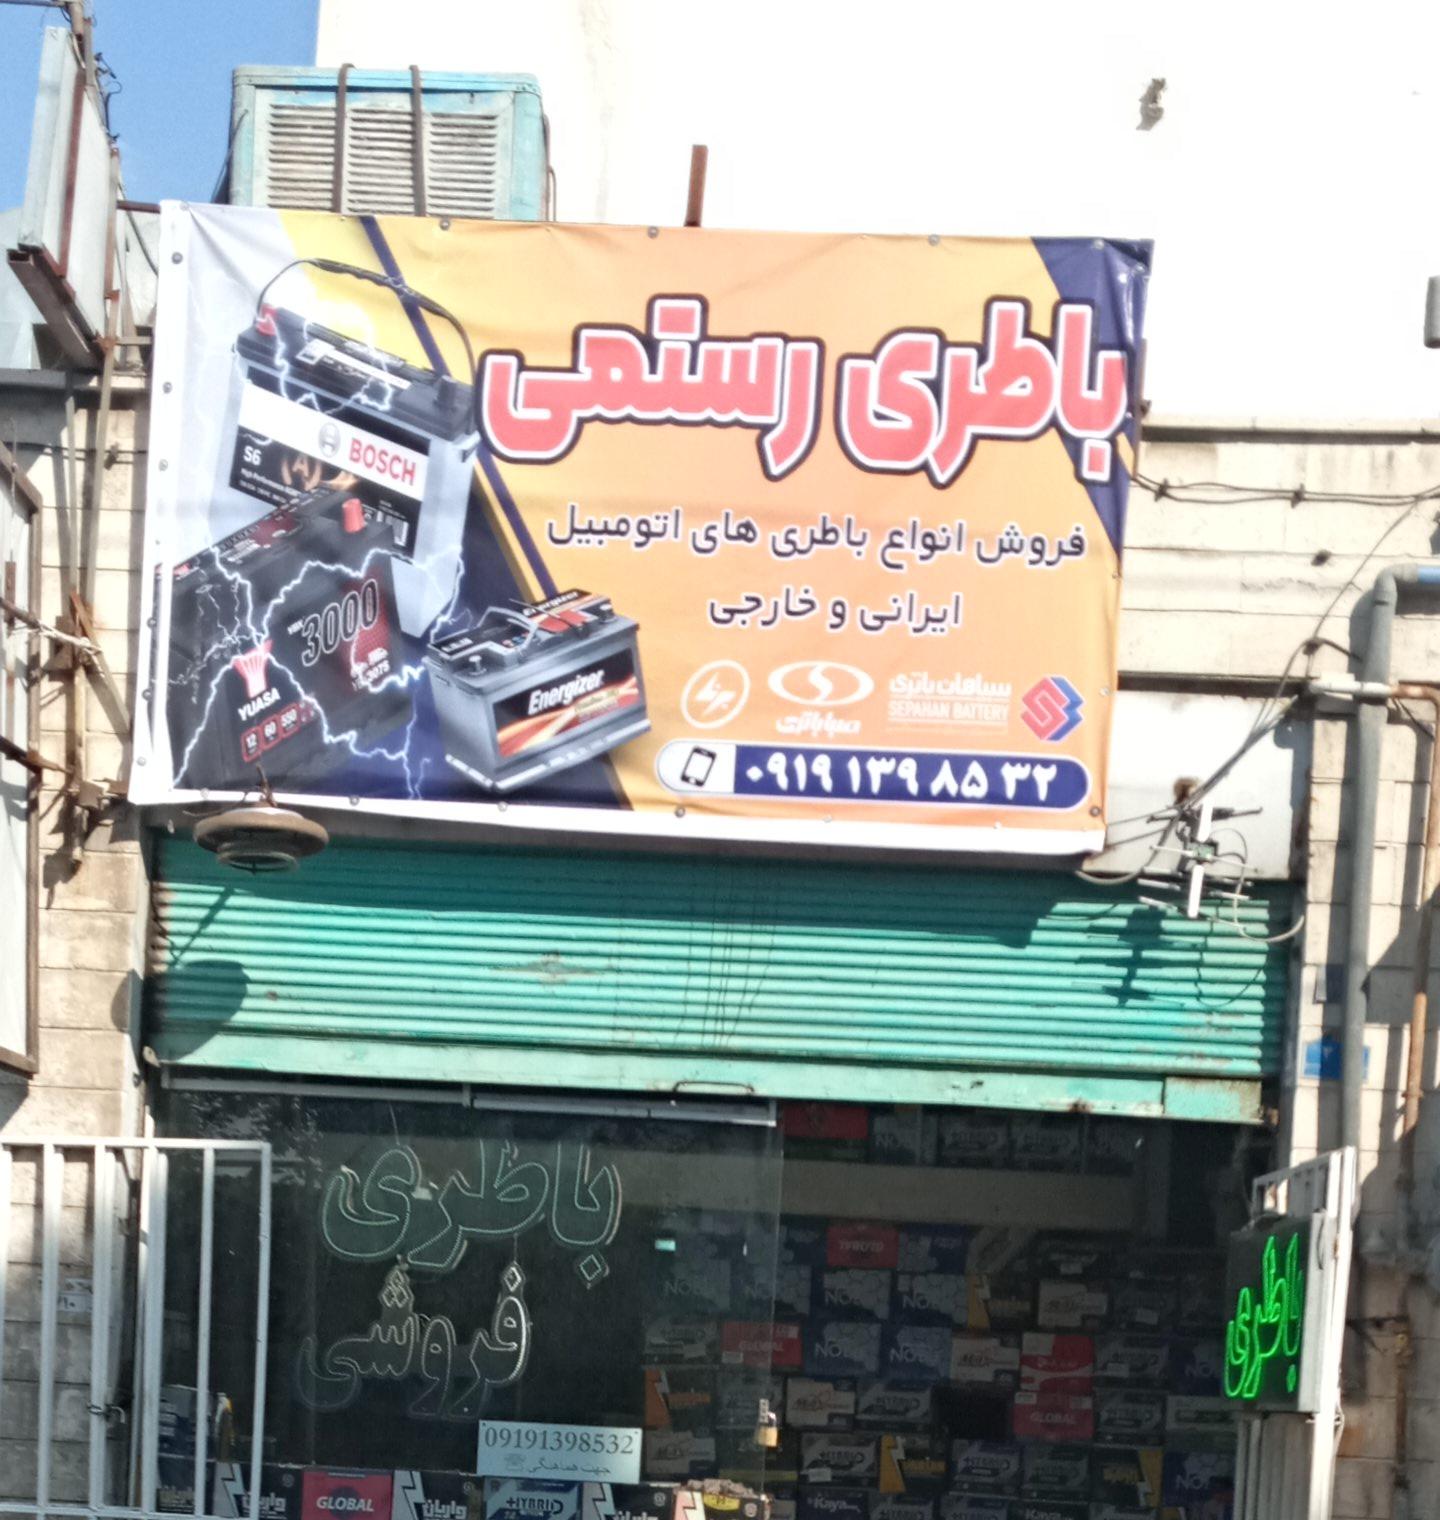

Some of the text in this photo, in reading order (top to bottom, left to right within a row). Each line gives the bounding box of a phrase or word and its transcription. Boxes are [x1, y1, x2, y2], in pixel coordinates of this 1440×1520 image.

[481, 297, 1129, 484] باطری رستمی
[243, 445, 262, 466] S6
[349, 437, 417, 486] BOSCH
[547, 504, 1088, 569] فروش انواع باطری های اتومبیل
[301, 578, 379, 668] 3000
[708, 587, 961, 633] ایرانی و خارجی
[237, 687, 281, 721] YUASA
[527, 669, 605, 716] Energizer
[888, 700, 1010, 723] SEPAHAN BATTERY
[321, 1139, 617, 1284] باطری
[1224, 1232, 1304, 1399] باطری
[299, 1264, 530, 1419] فروشی
[484, 1426, 634, 1455] 09191398532
[315, 1495, 375, 1513] GLOBAL
[422, 1498, 468, 1520] واریان
